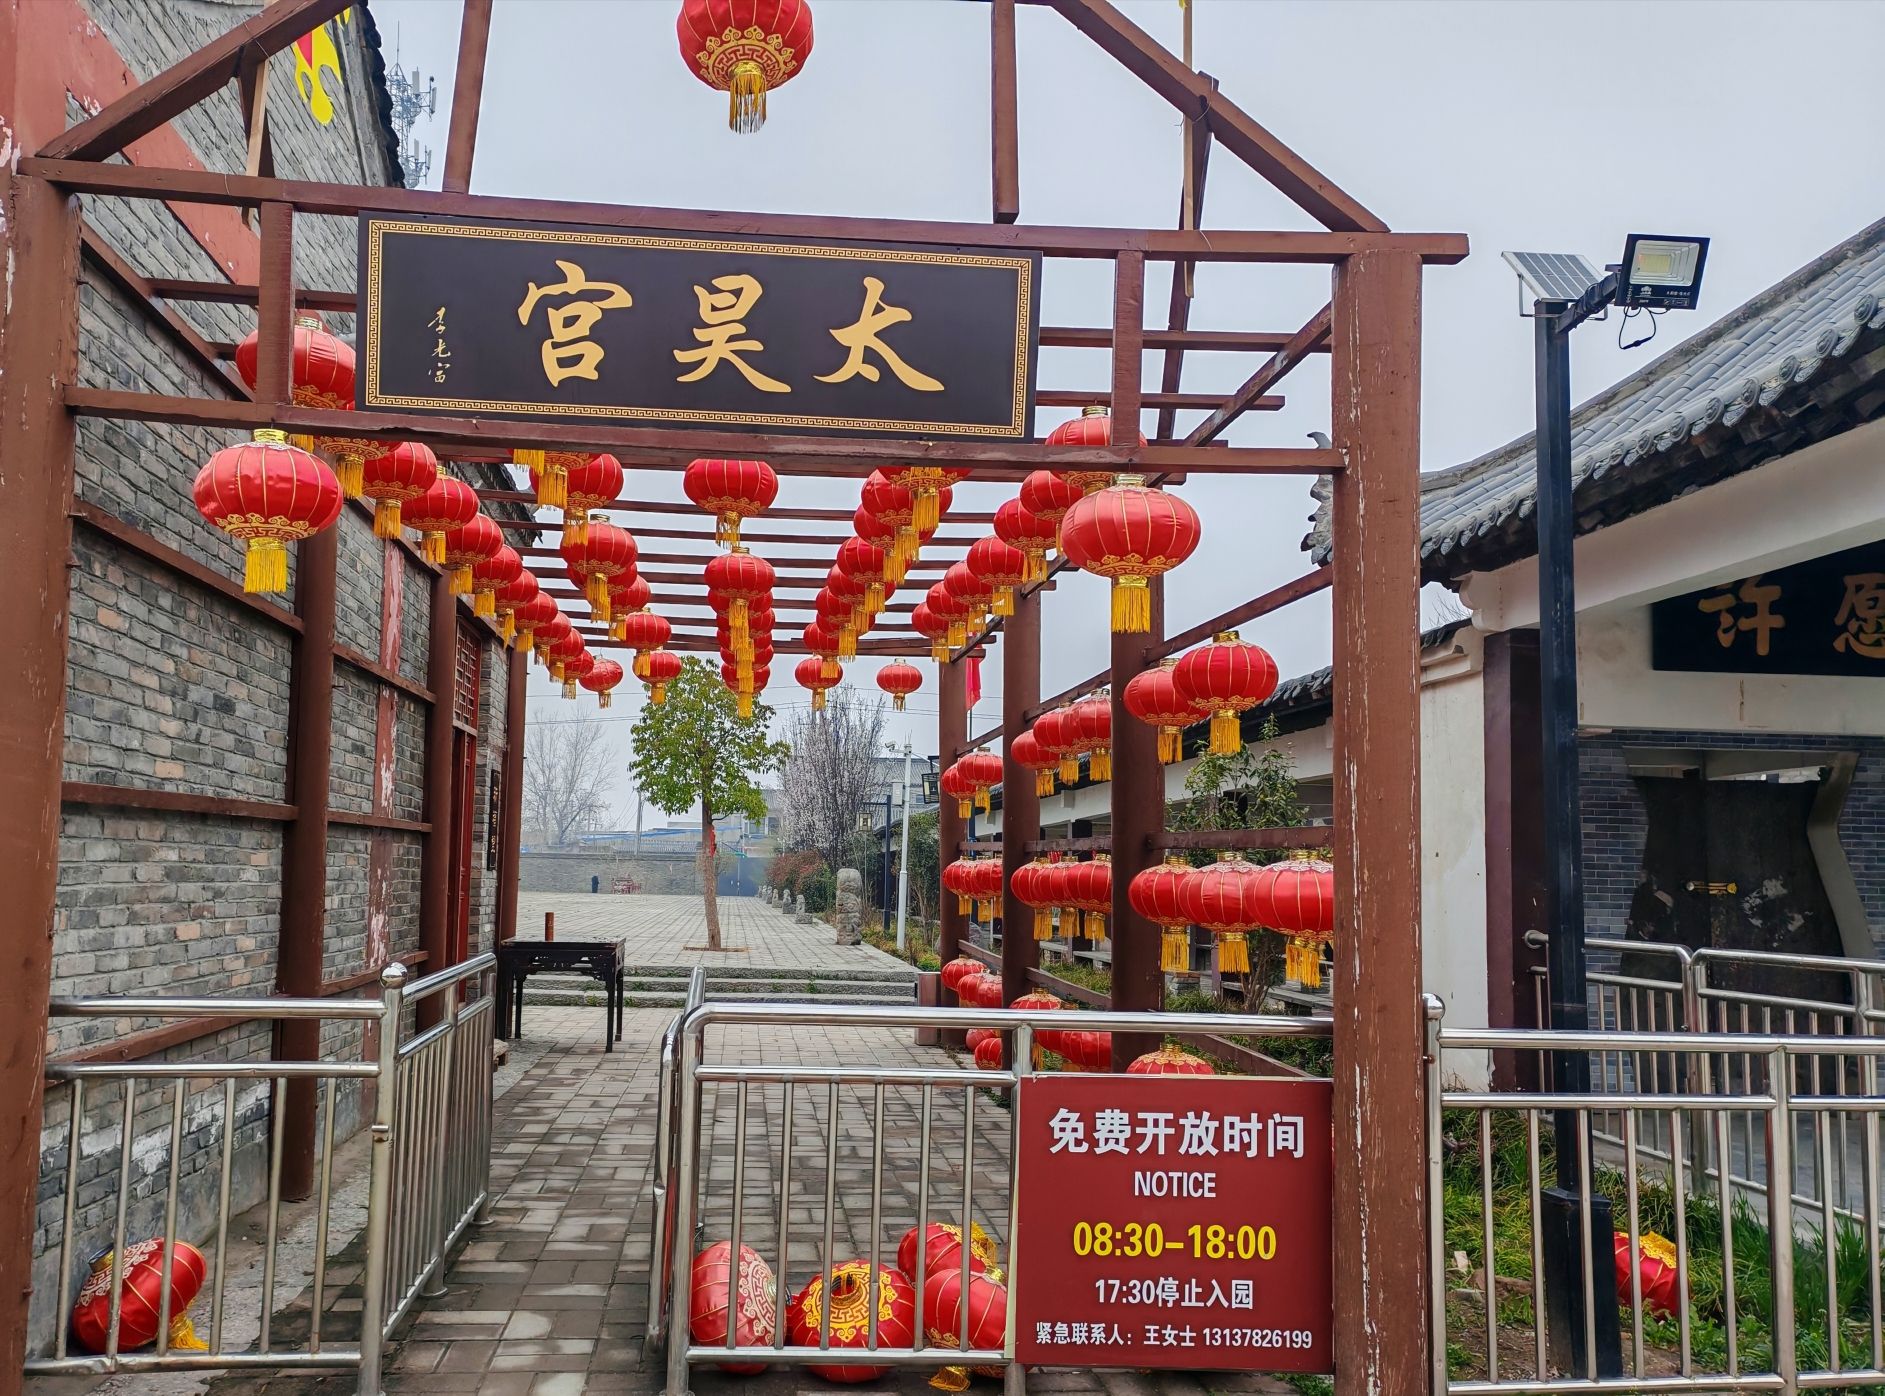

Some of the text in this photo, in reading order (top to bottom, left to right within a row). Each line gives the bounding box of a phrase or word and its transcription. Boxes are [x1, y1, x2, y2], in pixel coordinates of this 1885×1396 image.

[518, 260, 945, 392] 太昊宫
[1049, 1108, 1305, 1158] 免费开放时间
[1134, 1171, 1216, 1198] NOTICE
[1073, 1221, 1277, 1260] 08:30-18:00
[1095, 1276, 1253, 1310] 17:30停止入园
[1202, 1327, 1312, 1349] 13137826199
